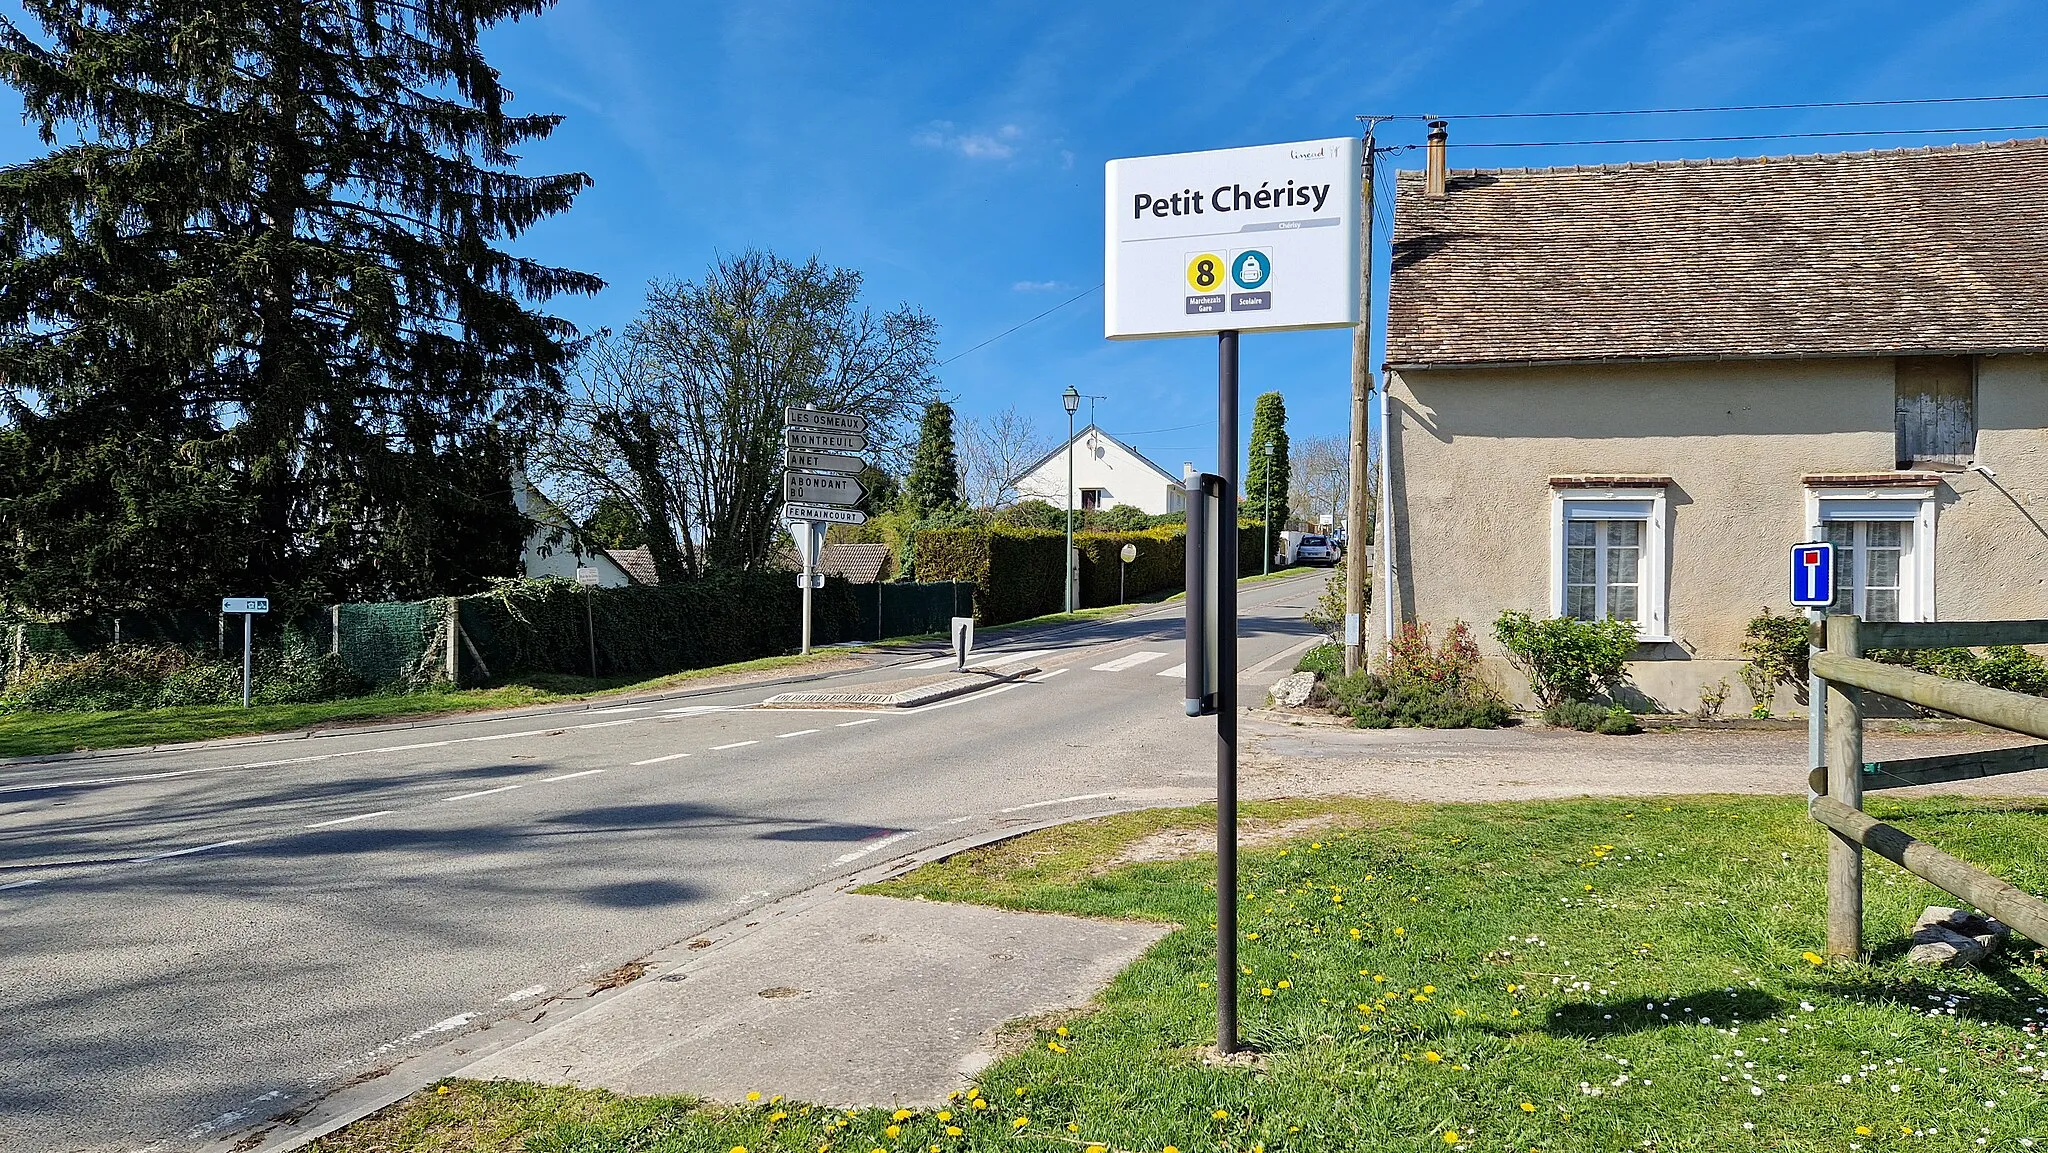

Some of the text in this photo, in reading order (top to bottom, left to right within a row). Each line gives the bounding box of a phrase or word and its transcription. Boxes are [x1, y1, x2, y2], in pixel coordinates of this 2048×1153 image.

[1134, 180, 1331, 219] Petit Chérisy
[1278, 222, 1301, 230] Chérisy
[1196, 259, 1215, 287] 8
[1189, 296, 1222, 305] Marchezais
[1239, 298, 1263, 306] Scolaire
[791, 412, 859, 428] LES OSMEAUX
[791, 434, 853, 447] MONTREUIL
[791, 455, 819, 466] ANET
[790, 477, 847, 490] ABONDANT
[789, 508, 856, 521] FERMAINCOURT
